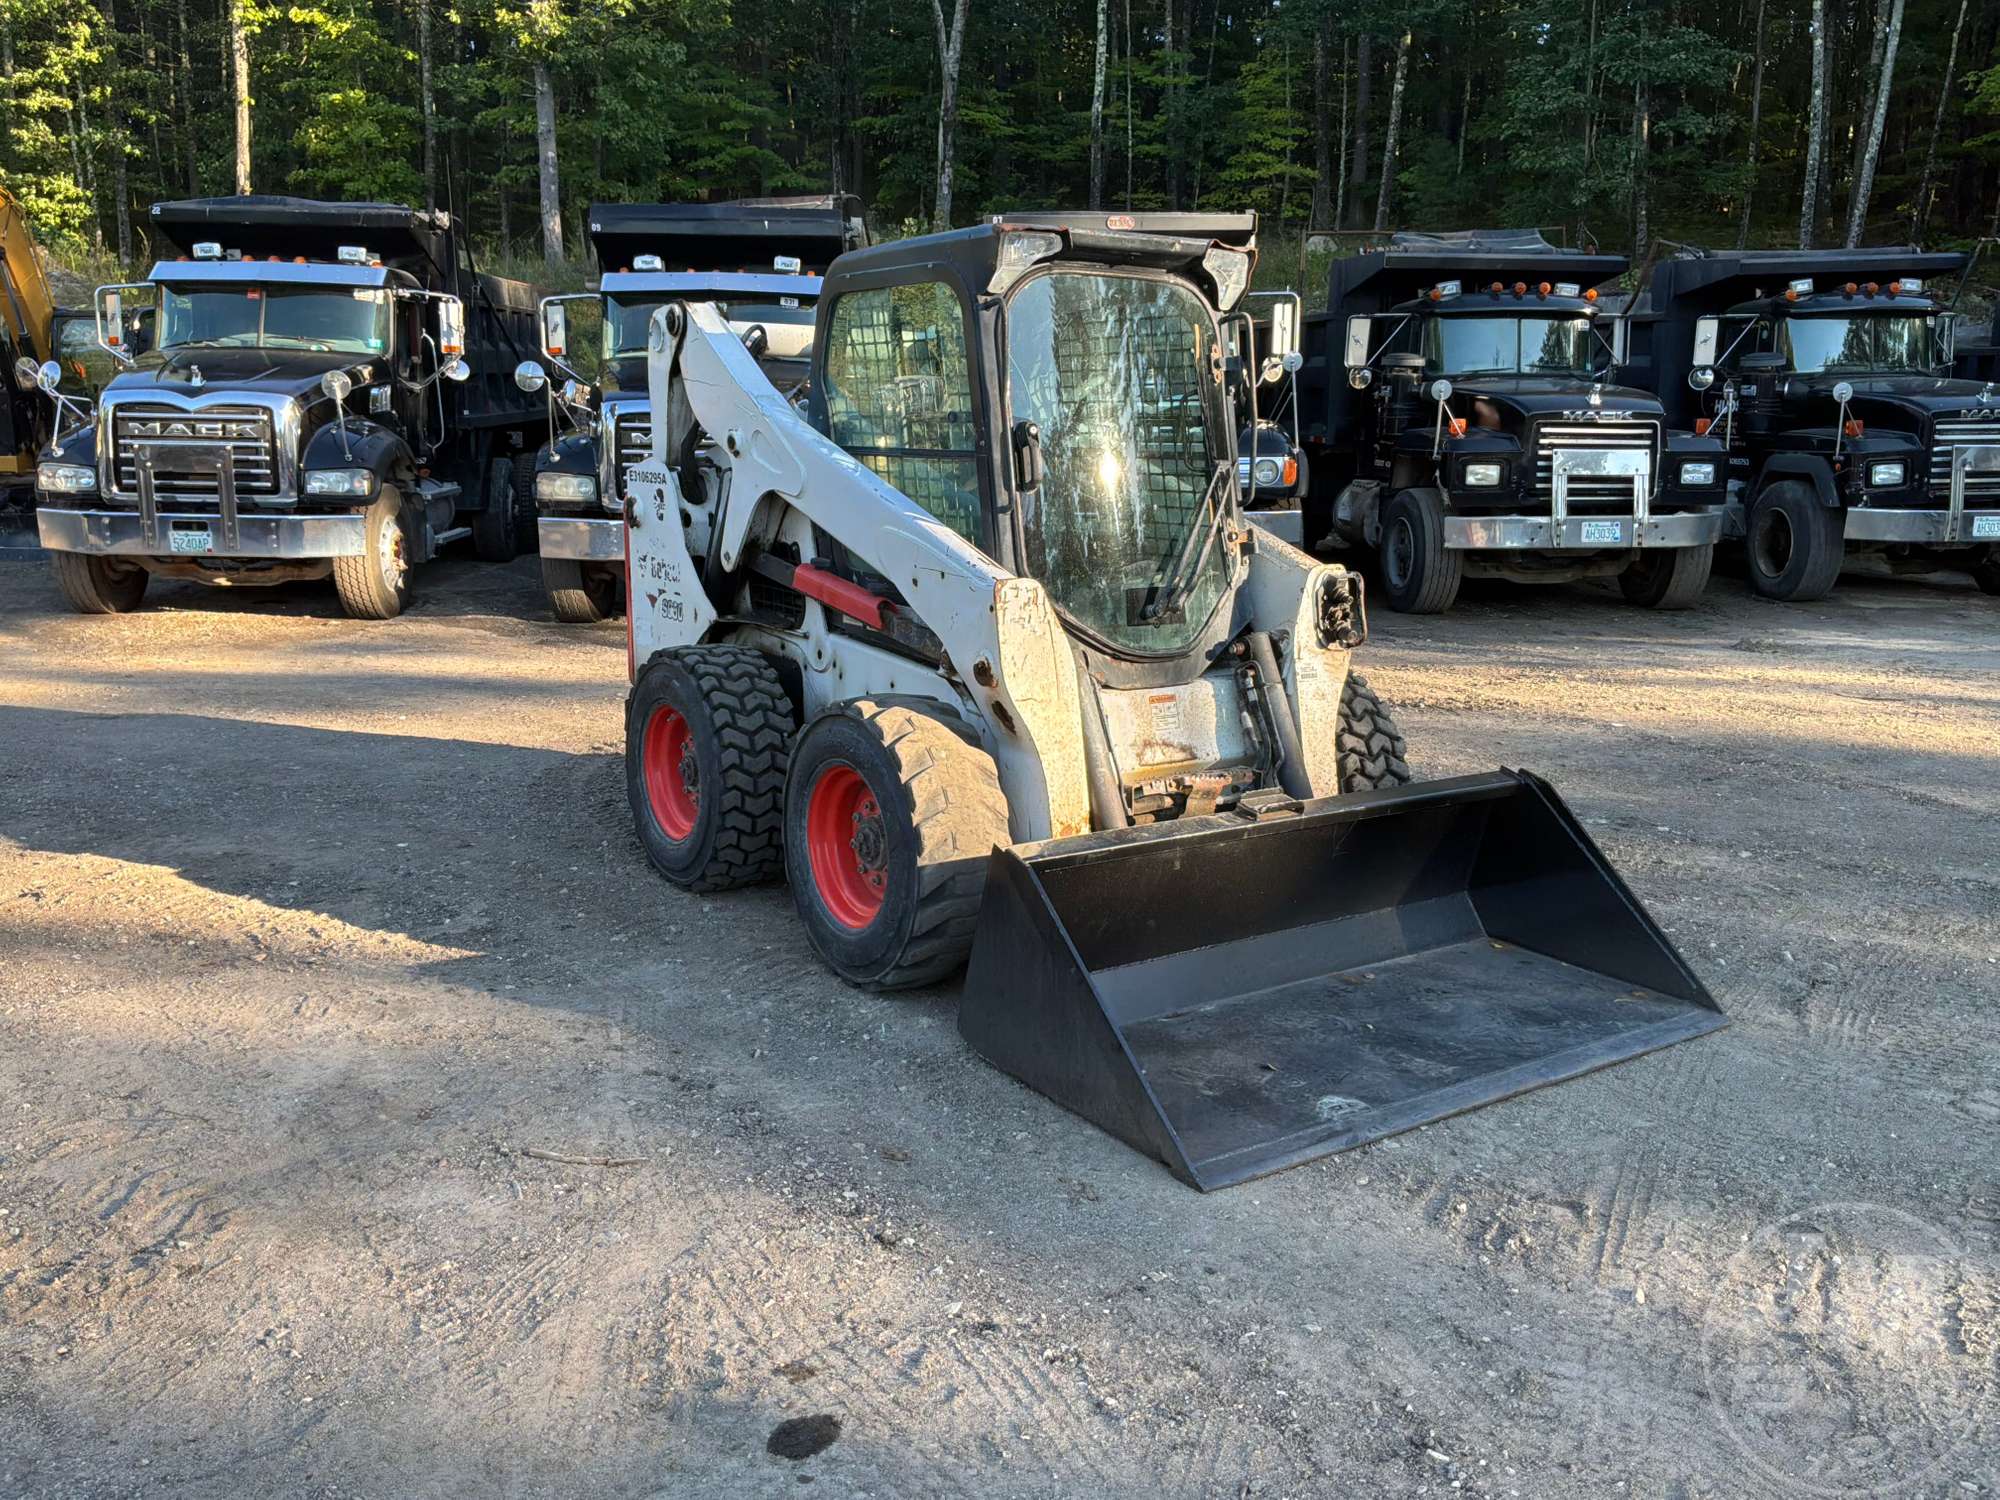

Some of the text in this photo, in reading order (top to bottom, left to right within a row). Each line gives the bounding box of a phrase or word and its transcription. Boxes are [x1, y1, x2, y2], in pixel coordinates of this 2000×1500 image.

[151, 206, 161, 215] 22
[591, 223, 601, 232] 09
[1562, 410, 1633, 421] MACK
[127, 422, 258, 437] MACK
